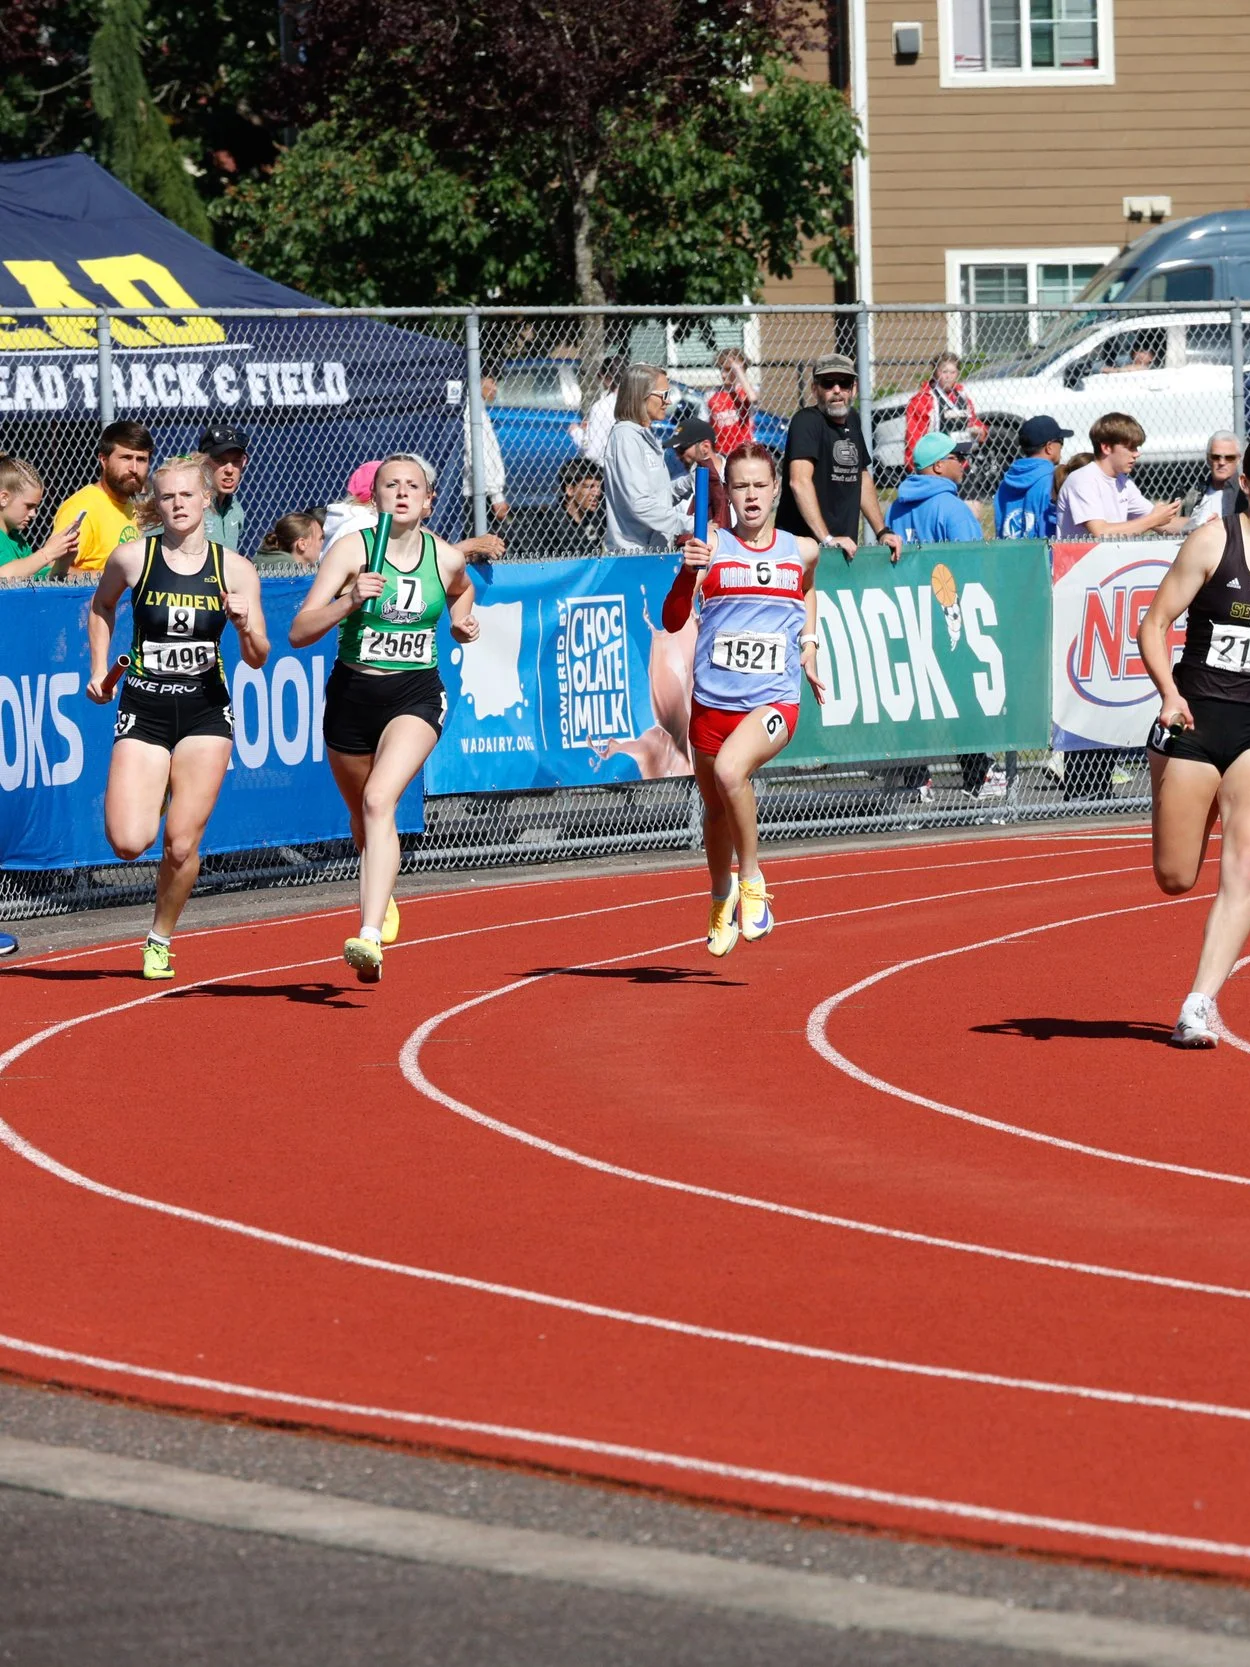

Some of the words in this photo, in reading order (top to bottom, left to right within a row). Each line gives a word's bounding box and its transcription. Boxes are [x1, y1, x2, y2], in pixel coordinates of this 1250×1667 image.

[213, 363, 240, 405] &
[246, 362, 349, 406] FIELD
[755, 562, 772, 585] 6
[145, 591, 220, 611] LYNDEN
[402, 579, 416, 609] 7
[173, 608, 189, 633] 8
[556, 598, 567, 627] BY
[368, 631, 427, 658] 2569
[570, 605, 623, 658] CHOC
[153, 645, 209, 672] 1496
[573, 638, 625, 693] OLATE
[723, 640, 777, 671] 1521
[126, 676, 159, 694] NIKE
[556, 635, 572, 749] POWERED
[574, 693, 629, 737] MILK
[766, 714, 783, 735] 6
[460, 736, 535, 754] WADAIRY.ORG
